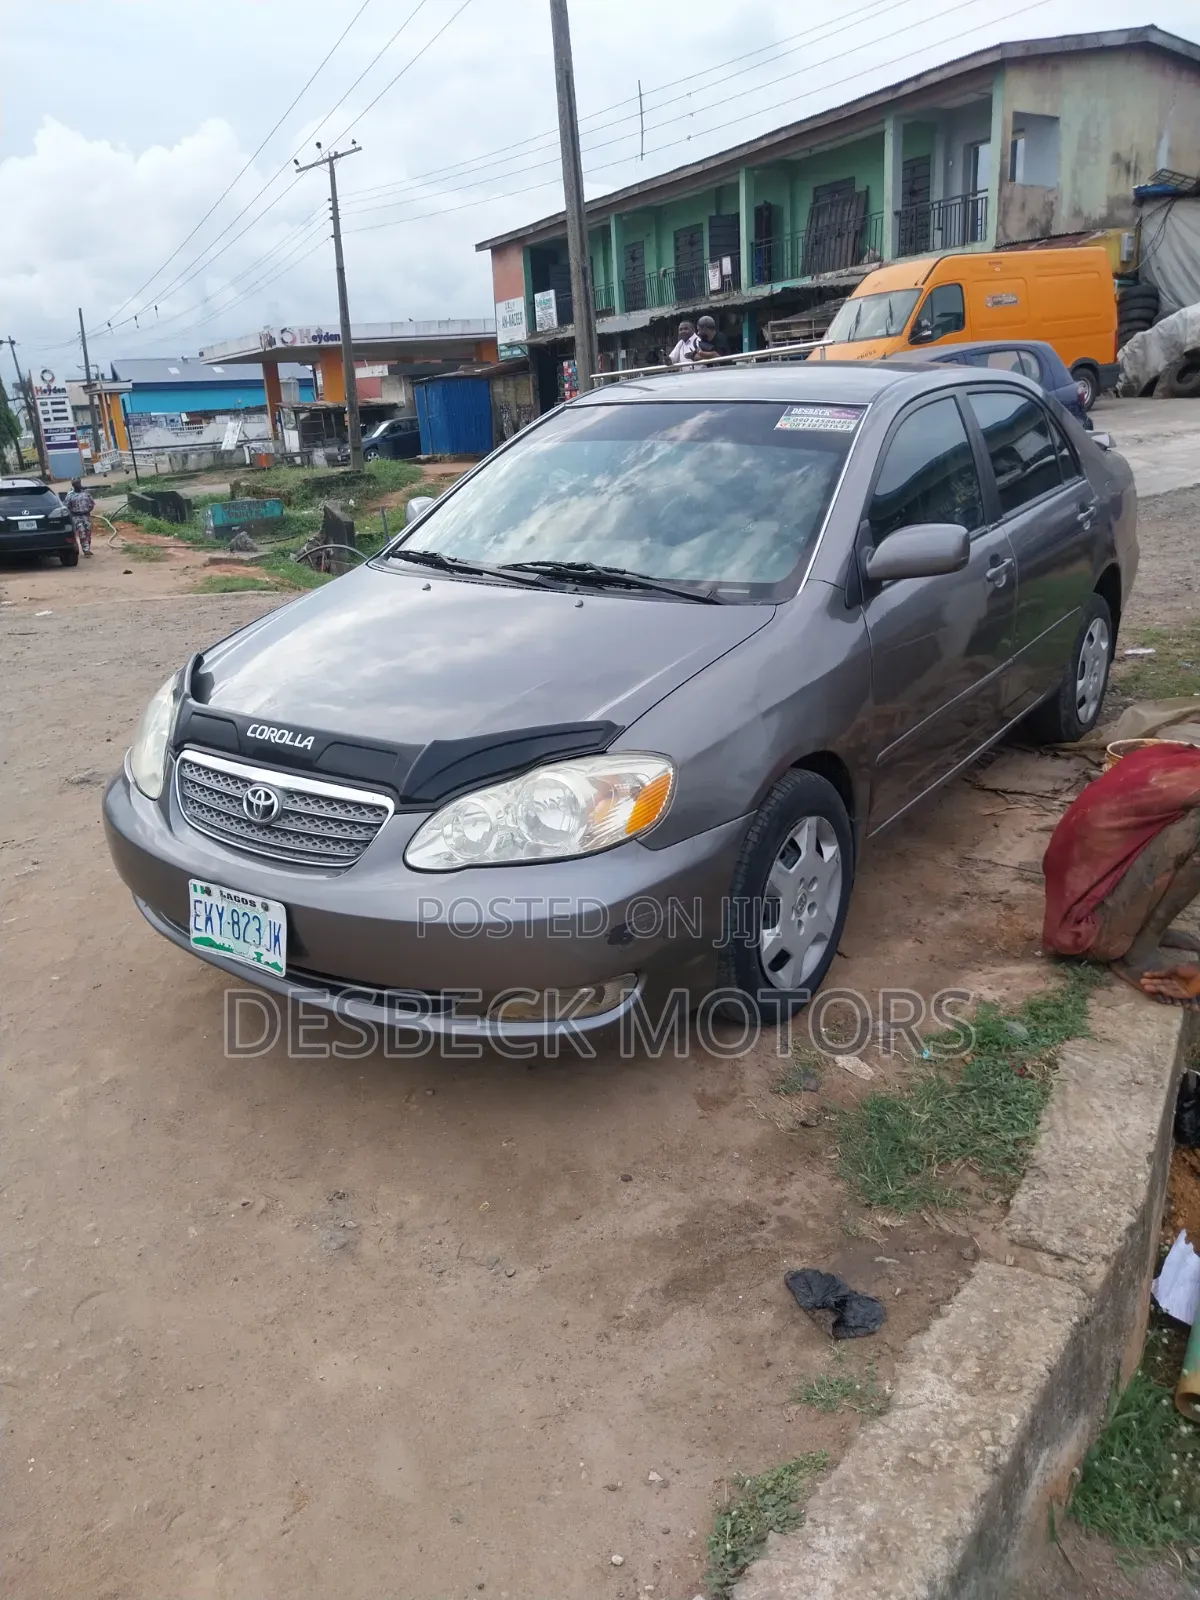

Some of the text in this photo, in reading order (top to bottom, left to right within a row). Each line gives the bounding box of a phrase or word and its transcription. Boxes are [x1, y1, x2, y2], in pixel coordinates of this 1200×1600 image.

[299, 328, 341, 344] Heyden
[35, 386, 67, 395] Heyden
[791, 408, 831, 416] DESBECK
[246, 724, 315, 750] COROLLA
[219, 890, 257, 908] LAGOS
